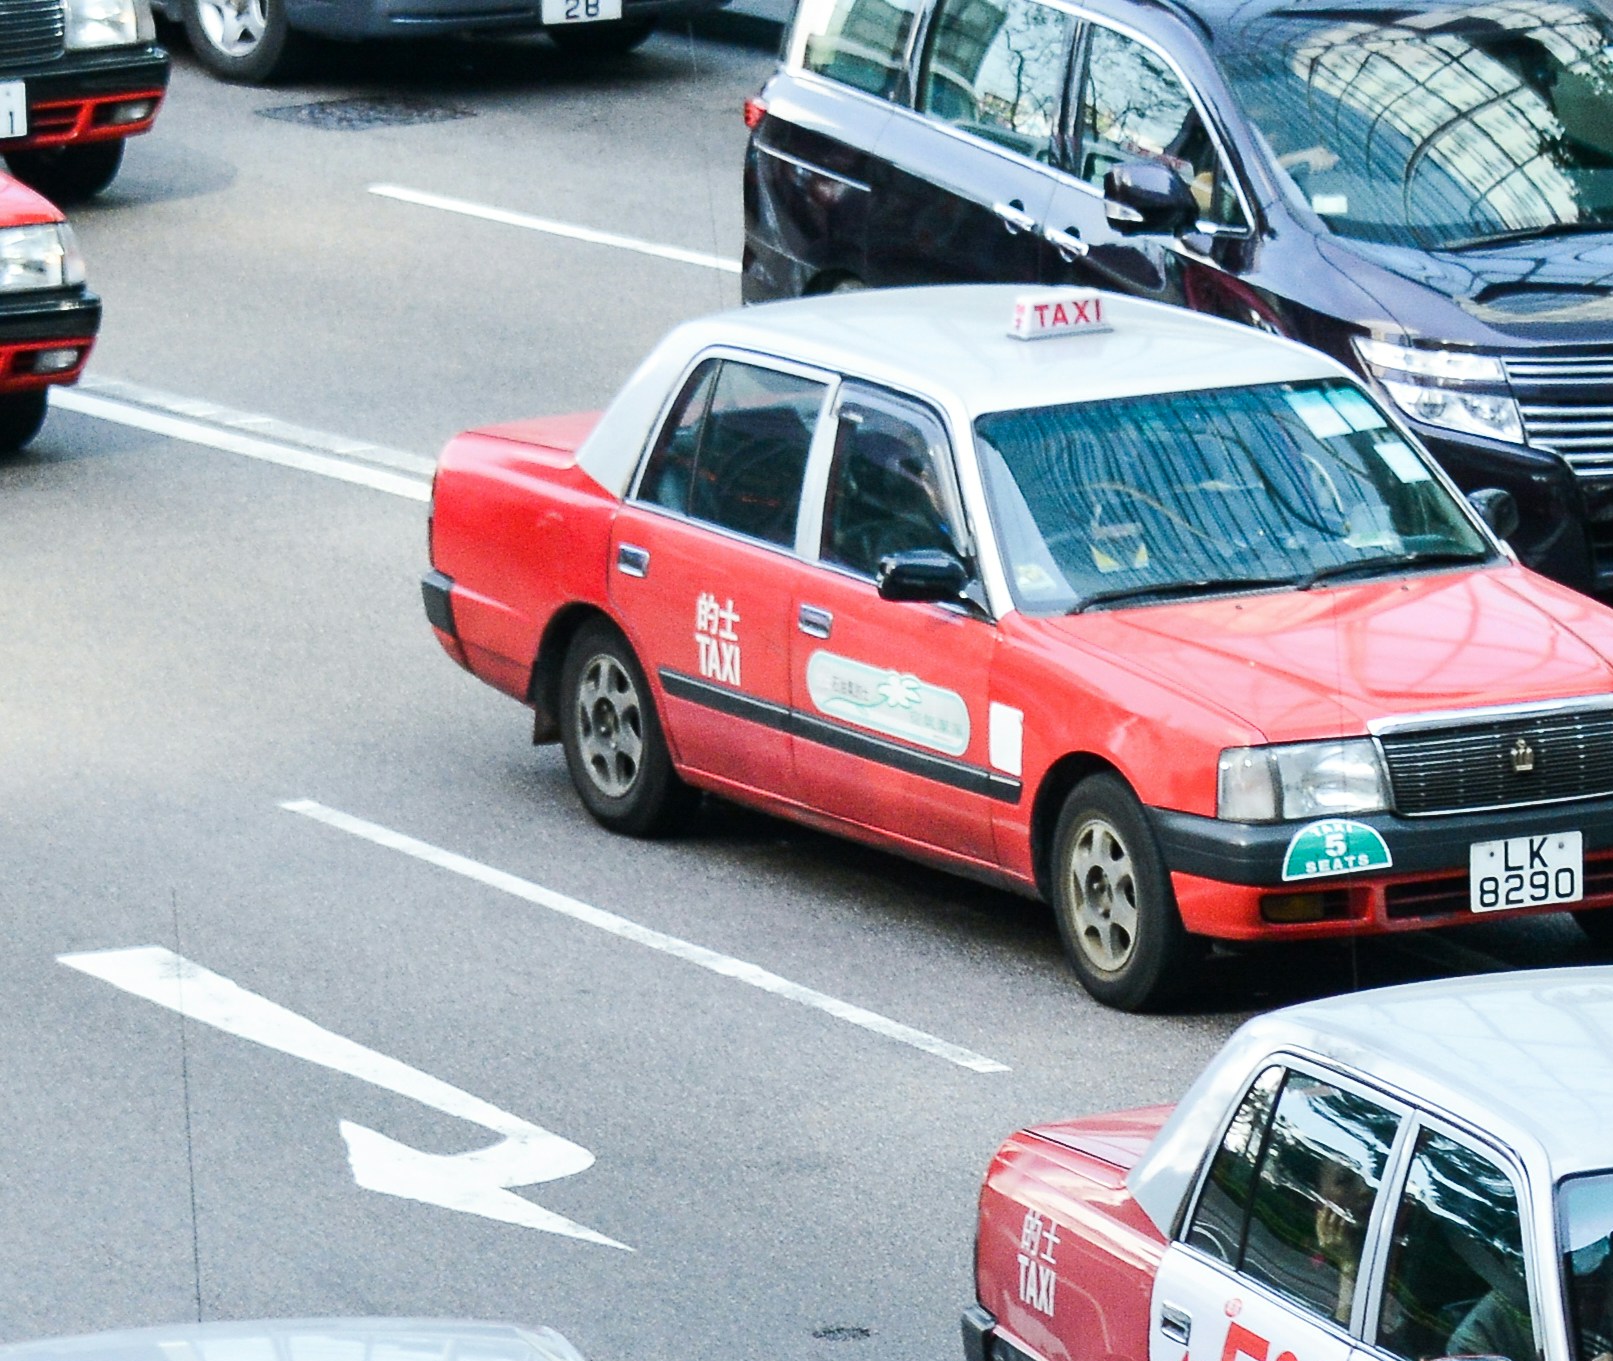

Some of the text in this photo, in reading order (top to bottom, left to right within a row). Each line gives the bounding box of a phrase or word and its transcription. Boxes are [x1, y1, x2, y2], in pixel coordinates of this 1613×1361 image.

[1034, 299, 1101, 327] TAXI
[695, 592, 741, 641] 的士
[695, 633, 741, 686] TAXI
[1305, 855, 1369, 874] SEATS
[1325, 834, 1347, 857] 5
[1503, 837, 1548, 872] LK
[1480, 867, 1576, 908] 8290
[1020, 1207, 1061, 1264] 的士
[1017, 1253, 1057, 1318] TAXI
